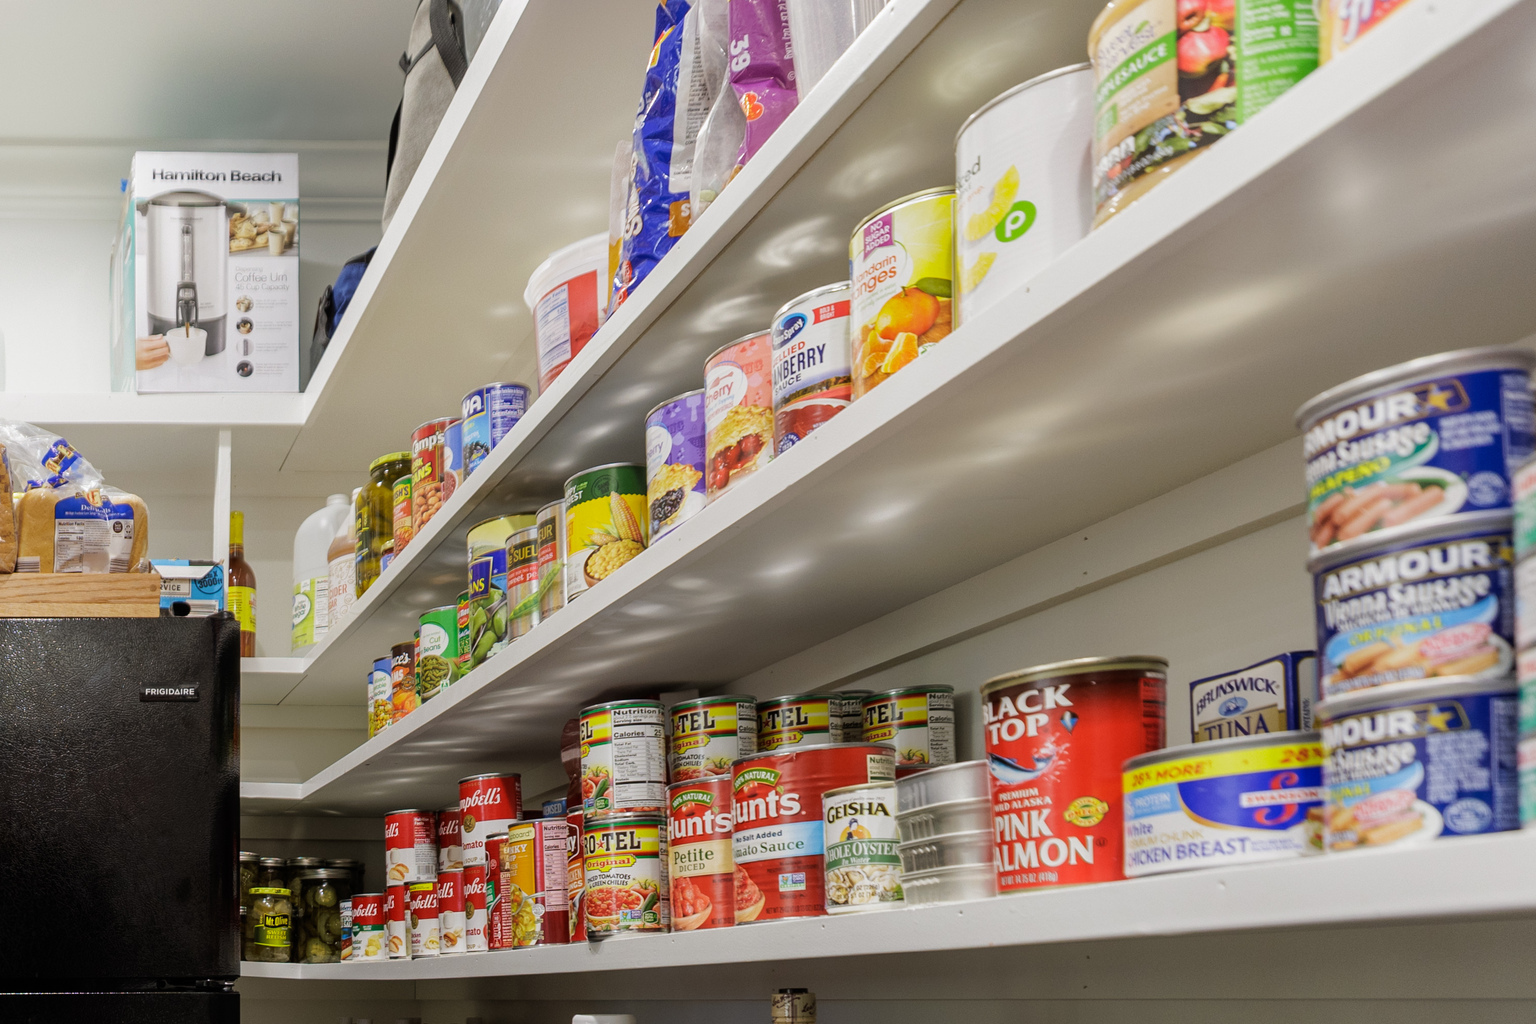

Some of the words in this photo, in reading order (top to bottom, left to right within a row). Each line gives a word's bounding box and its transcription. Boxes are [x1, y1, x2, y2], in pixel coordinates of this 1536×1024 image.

[152, 168, 226, 181] Hamilton
[230, 170, 282, 182] Beach
[870, 221, 883, 232] NO
[866, 225, 890, 243] SUGAR
[866, 235, 890, 253] ADDED
[235, 272, 266, 282] Coffee
[1323, 543, 1489, 598] ARMOUR
[145, 687, 195, 696] FRIGIDAIRE
[1196, 677, 1277, 715] BRUNSWICK
[613, 708, 658, 717] Nutrition
[613, 730, 644, 738] Calories
[988, 712, 1049, 745] TOP
[1204, 713, 1269, 741] TUNA
[746, 770, 776, 784] NATURAL
[686, 794, 712, 804] NATURAL
[1011, 796, 1052, 810] ALASKA
[827, 801, 889, 824] GEISHA
[995, 810, 1052, 842] PINK
[756, 831, 783, 840] Added
[761, 839, 804, 853] Sauce
[673, 847, 715, 865] Petite
[995, 835, 1094, 873] ALMON
[1128, 848, 1171, 866] CHICKEN
[587, 859, 632, 869] Original
[679, 862, 705, 872] DICED
